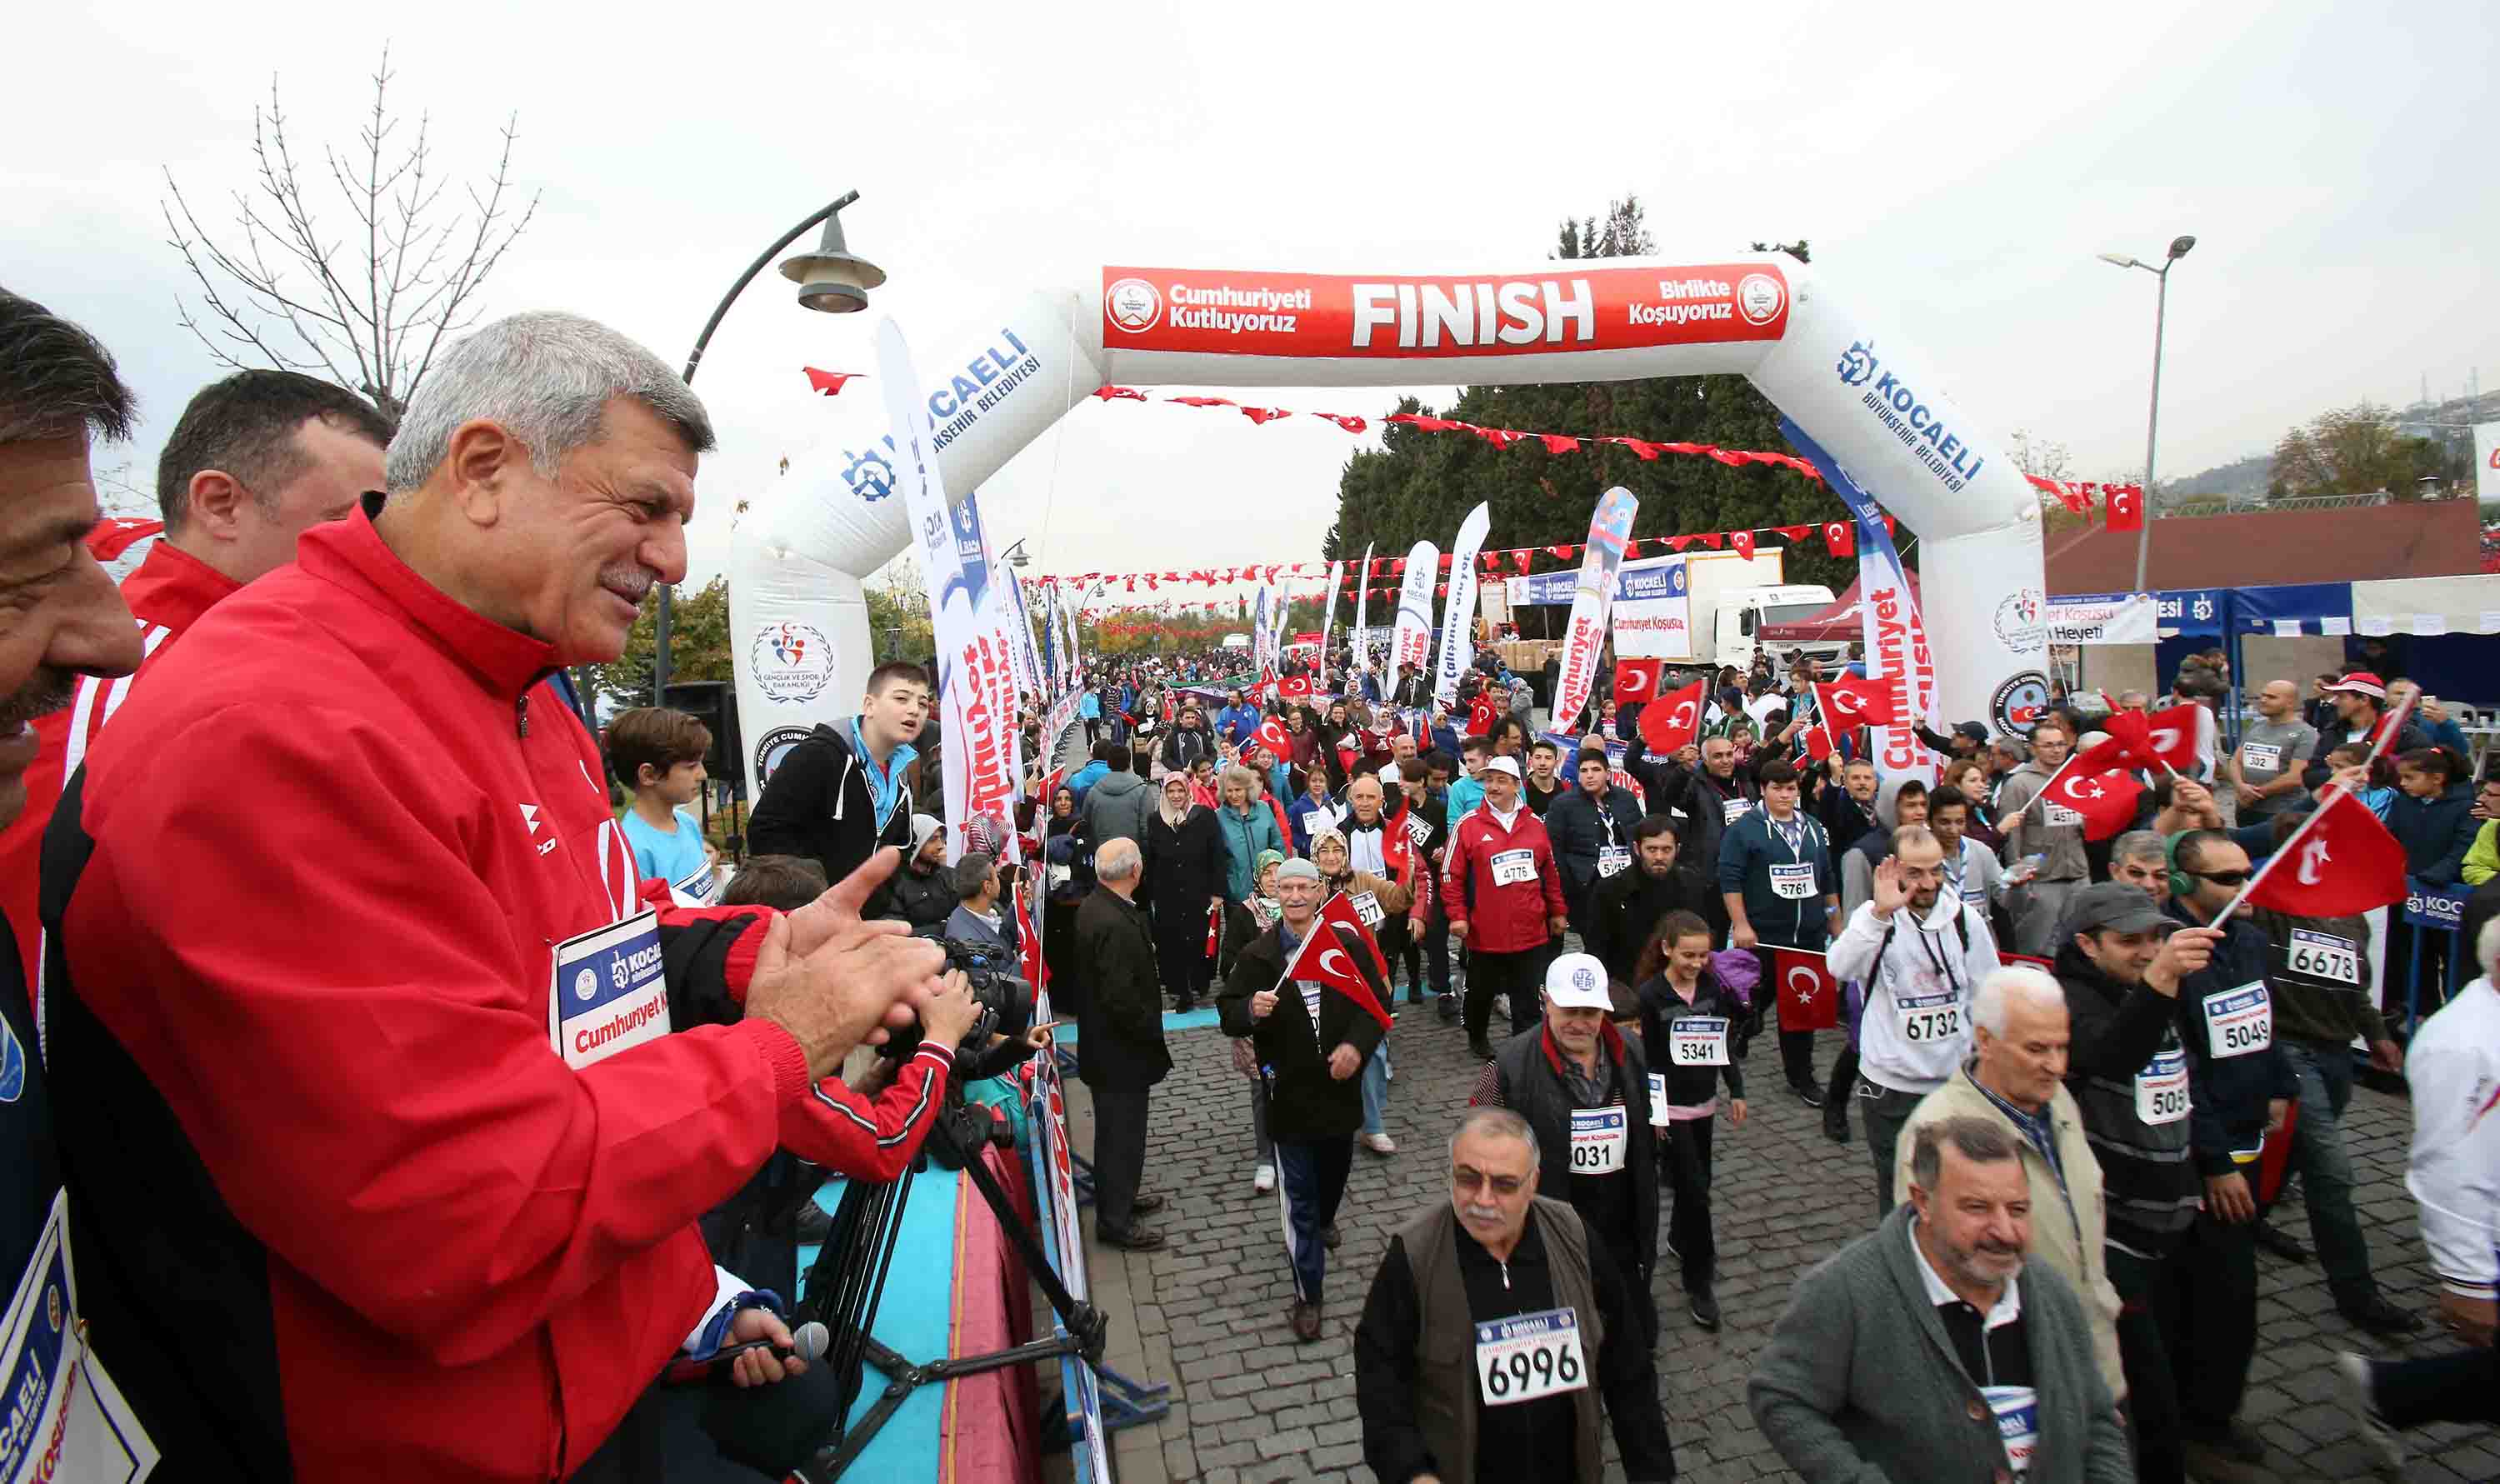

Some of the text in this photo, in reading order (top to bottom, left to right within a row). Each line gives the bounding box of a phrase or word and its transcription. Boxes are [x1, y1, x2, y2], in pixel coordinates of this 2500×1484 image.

[1169, 284, 1312, 312] Cumhuriyeti
[1659, 280, 1731, 299] Birlikte
[1169, 306, 1297, 334] Kutluyoruz
[1352, 279, 1594, 347] FINISH
[1628, 302, 1733, 326] Koşuyoruz
[932, 407, 978, 454] KŞEHİR
[977, 355, 1042, 412] BELEDİYESİ
[1874, 371, 1985, 481] KOCAELİ
[2158, 597, 2182, 618] ESİ
[2054, 624, 2104, 642] Heyeti
[1503, 866, 1528, 879] 4776
[1781, 882, 1807, 896] 5761
[2426, 896, 2466, 915] KOC
[628, 942, 662, 973] KOCA
[2295, 947, 2355, 980] 6678
[575, 996, 661, 1053] Cumhuriyet
[1906, 1010, 1958, 1041] 6732
[2226, 1019, 2268, 1049] 5049
[1682, 1043, 1713, 1060] 5341
[1571, 1145, 1609, 1167] 031
[1488, 1343, 1580, 1397] 6996
[0, 1347, 42, 1454] CAELİ
